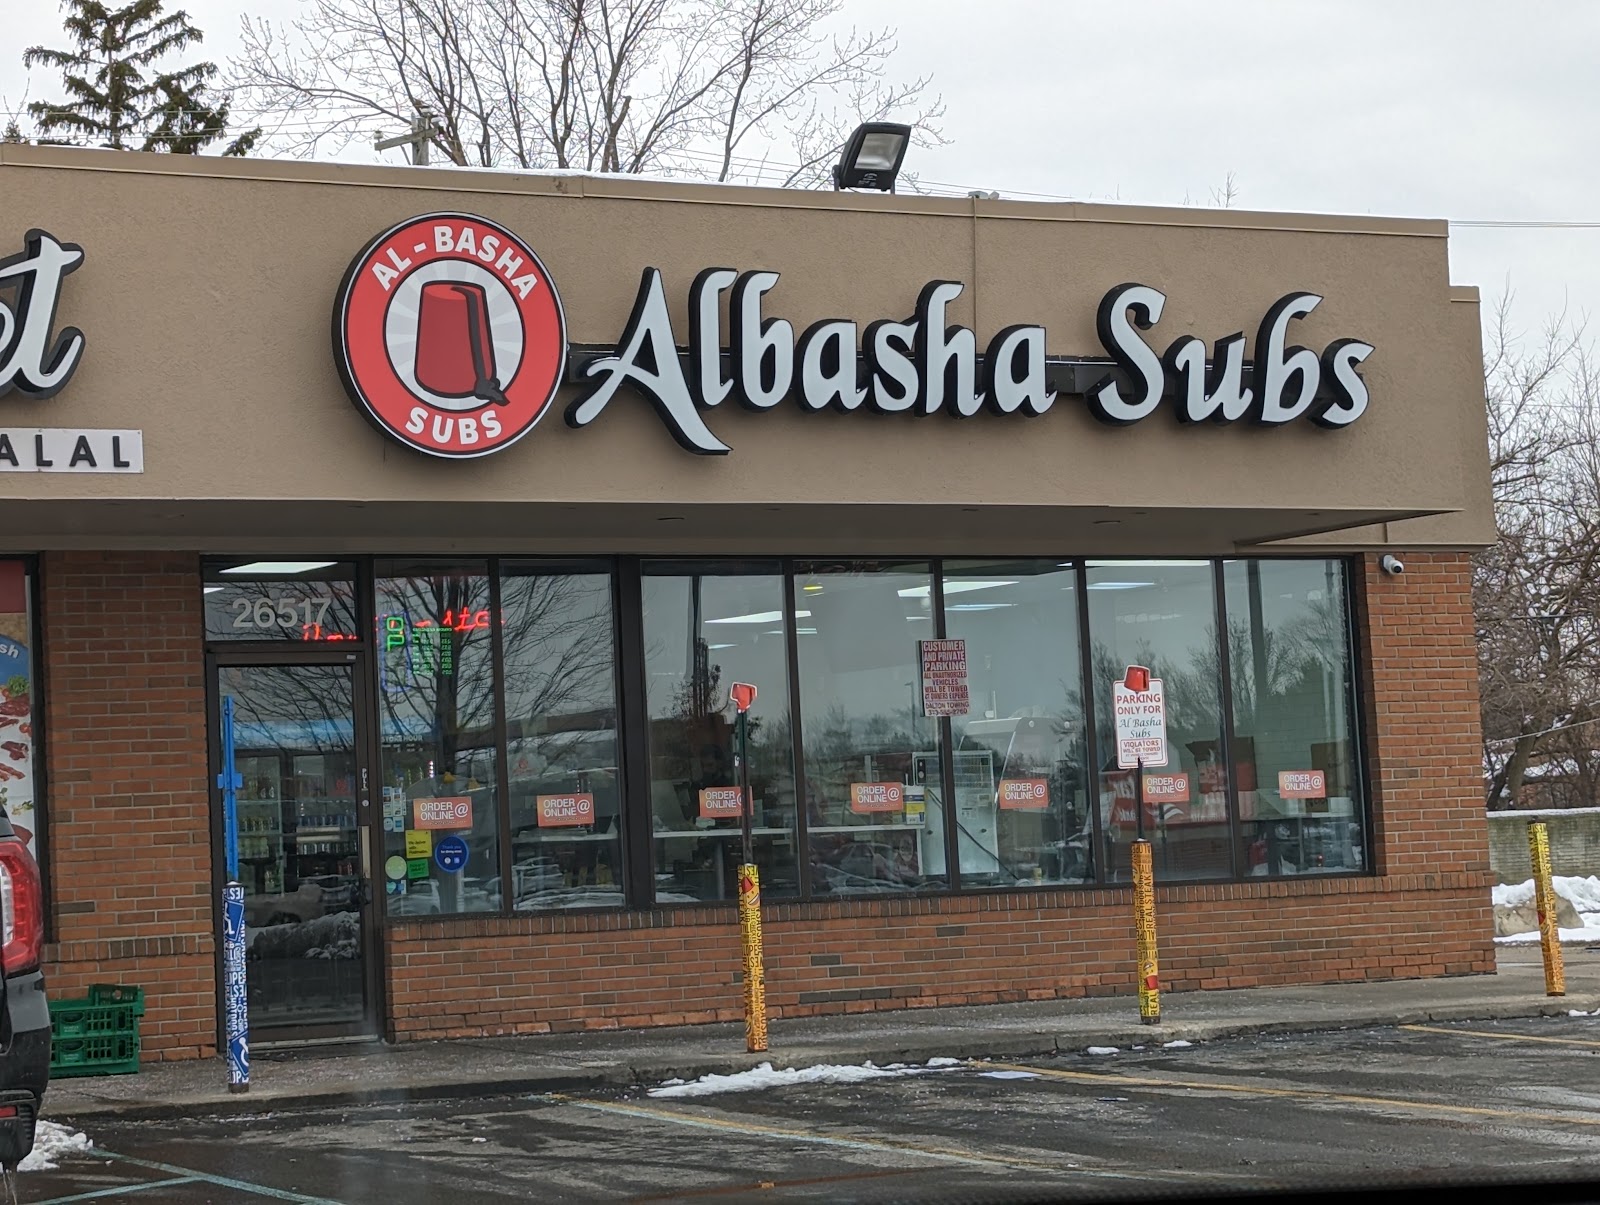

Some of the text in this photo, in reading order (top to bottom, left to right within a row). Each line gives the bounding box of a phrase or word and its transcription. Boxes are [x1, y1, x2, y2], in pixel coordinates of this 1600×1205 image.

[371, 225, 539, 300] AL-BASHA
[568, 266, 1377, 456] Albasha Subs
[405, 407, 503, 446] SUBS
[232, 597, 332, 628] 26517
[923, 640, 965, 652] CUSTOMER
[924, 650, 965, 662] AND PRIVATE
[924, 661, 966, 671] PARKING
[932, 671, 967, 679] UNAUTHORIZED
[932, 678, 959, 686] VEHICLES
[938, 685, 946, 693] BE
[947, 685, 968, 693] TOWED
[1116, 693, 1161, 704] PARKING
[946, 701, 969, 709] TOWING
[1117, 705, 1161, 715] ONLY FOR
[1119, 716, 1162, 728] Al Basha
[1130, 728, 1151, 739] Subs
[1123, 740, 1159, 748] VIOLATORS
[1146, 777, 1174, 786] ORDER
[1283, 774, 1311, 783] ORDER
[856, 785, 886, 795] ORDER
[1004, 783, 1032, 792] ORDER
[1147, 785, 1176, 794] ONLINE
[1284, 782, 1312, 791] ONLINE
[705, 790, 736, 800] ORDER
[857, 794, 888, 803] ONLINE
[1004, 791, 1034, 800] ONLINE
[420, 801, 453, 811] ORDER
[543, 798, 576, 809] ORDER
[705, 800, 737, 809] ONLINE
[420, 811, 455, 821] ONLINE
[543, 807, 577, 817] ONLINE
[1144, 874, 1154, 929] REAL STEAK
[1149, 991, 1158, 1016] REAL
